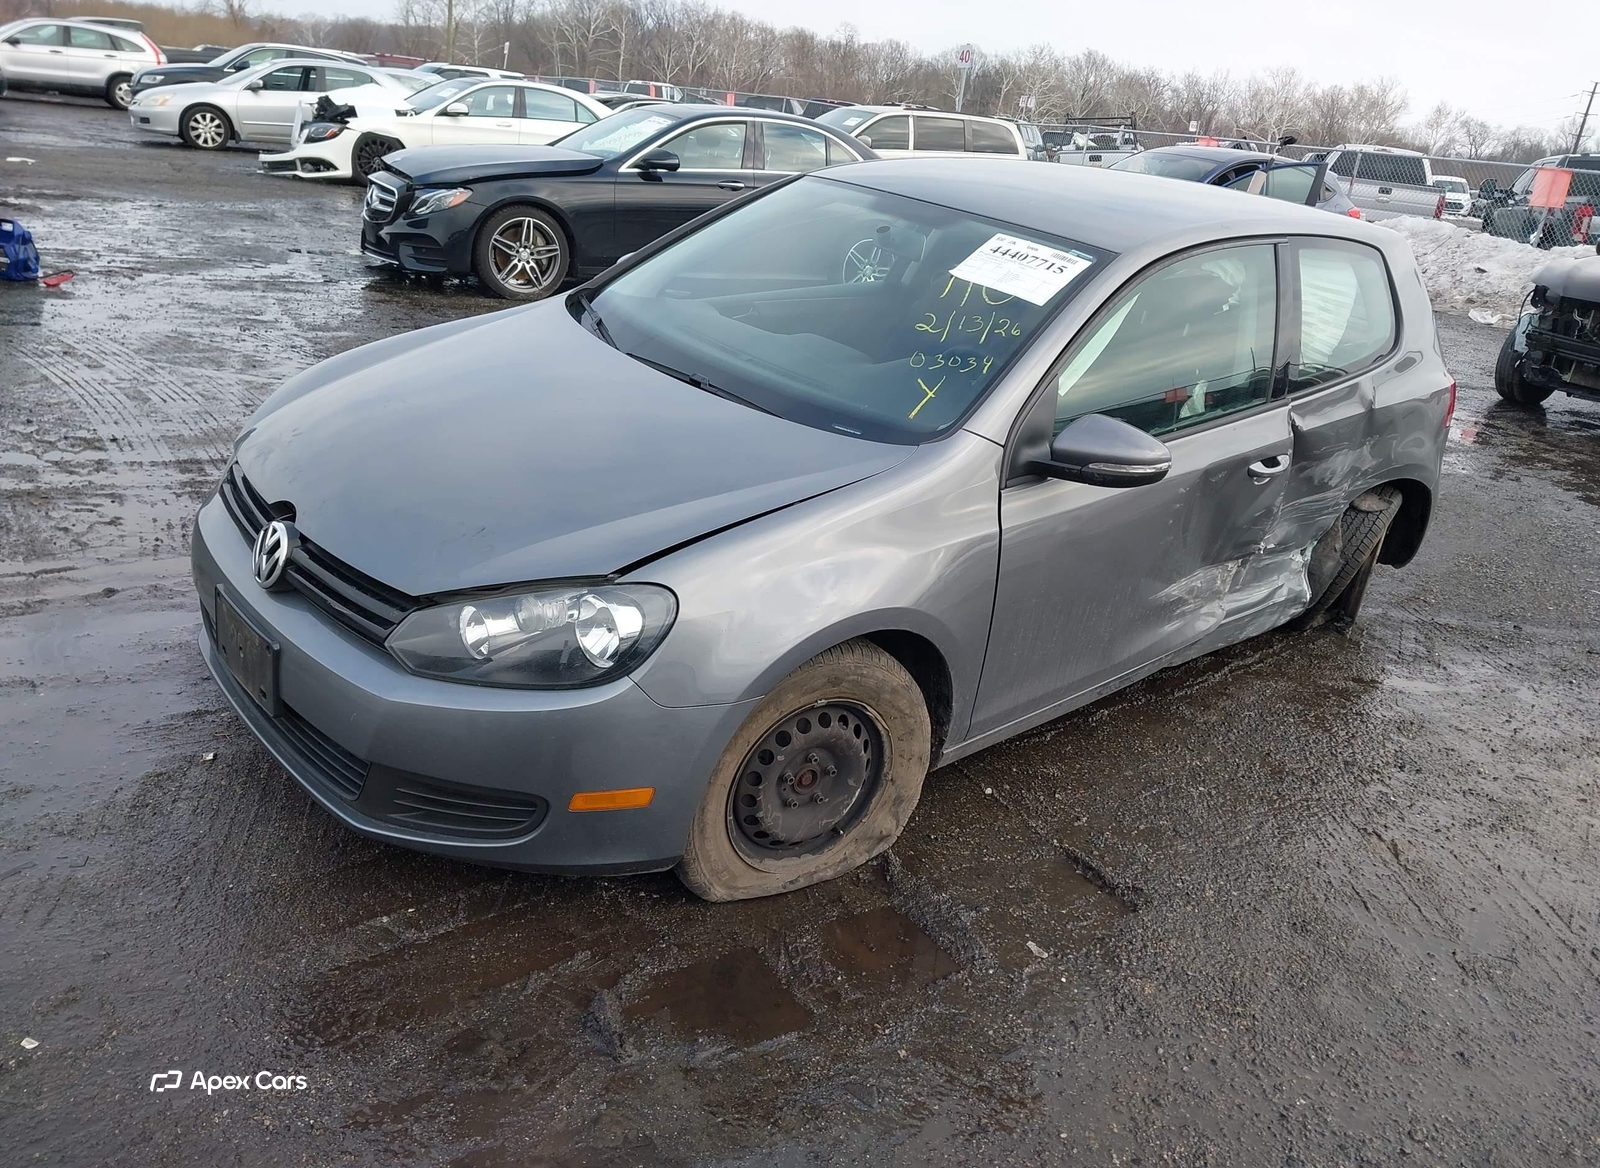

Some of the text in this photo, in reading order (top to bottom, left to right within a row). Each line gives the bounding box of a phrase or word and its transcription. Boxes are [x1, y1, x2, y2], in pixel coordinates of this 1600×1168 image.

[959, 49, 971, 64] 40
[989, 245, 1068, 275] 44407715
[914, 310, 1021, 344] 2/13/26
